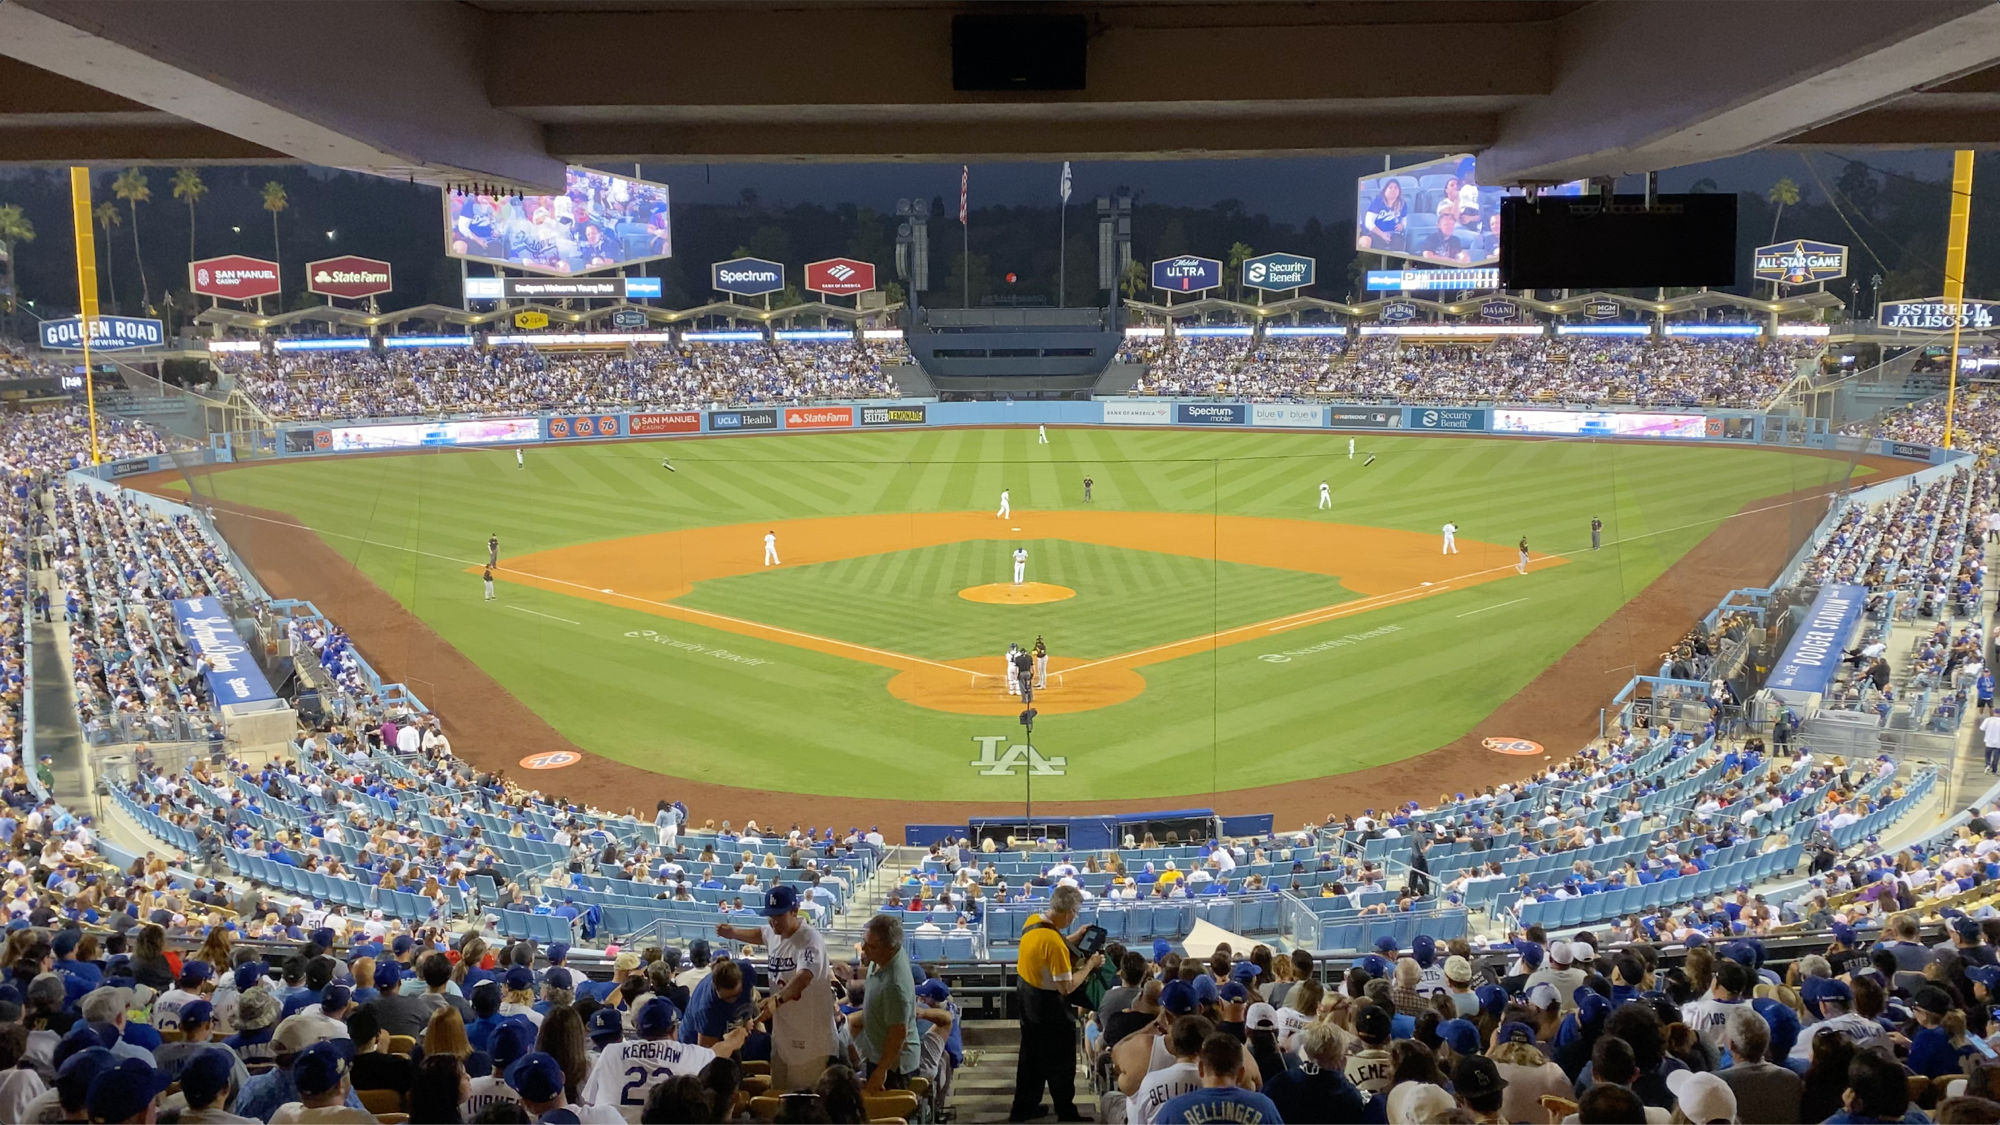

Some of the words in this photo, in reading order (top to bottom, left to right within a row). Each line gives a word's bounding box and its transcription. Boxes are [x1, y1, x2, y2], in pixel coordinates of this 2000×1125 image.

[1807, 256, 1840, 267] GAME
[1167, 267, 1205, 277] ULTRA
[1269, 262, 1306, 273] Security
[215, 270, 235, 279] SAN
[237, 270, 275, 280] MANUEL
[720, 270, 775, 284] Spectrum
[1270, 272, 1301, 282] Benefit
[1385, 305, 1397, 316] JIM
[1483, 306, 1513, 314] DASANI
[1889, 315, 1969, 327] JALISCO
[115, 321, 158, 342] ROAD
[84, 339, 124, 347] REWING
[1188, 406, 1231, 417] Spectrum
[1256, 410, 1275, 418] blue
[1290, 411, 1308, 419] blue
[1441, 411, 1472, 421] Security
[641, 416, 660, 424] SAN
[661, 415, 697, 424] MANUEL
[717, 417, 738, 425] UCLA
[743, 415, 772, 425] Health
[864, 413, 889, 422] SELTZER
[553, 423, 566, 433] 76
[577, 422, 590, 432] 76
[601, 421, 614, 430] 76
[1441, 419, 1467, 428] Benefit
[1708, 423, 1720, 431] 76
[316, 434, 329, 443] 76
[1812, 599, 1850, 630] STADIUM
[1792, 630, 1835, 666] DODGER
[969, 736, 1067, 775] LA
[622, 1042, 681, 1063] KERSHAW
[1184, 1101, 1263, 1125] BELLINGER
